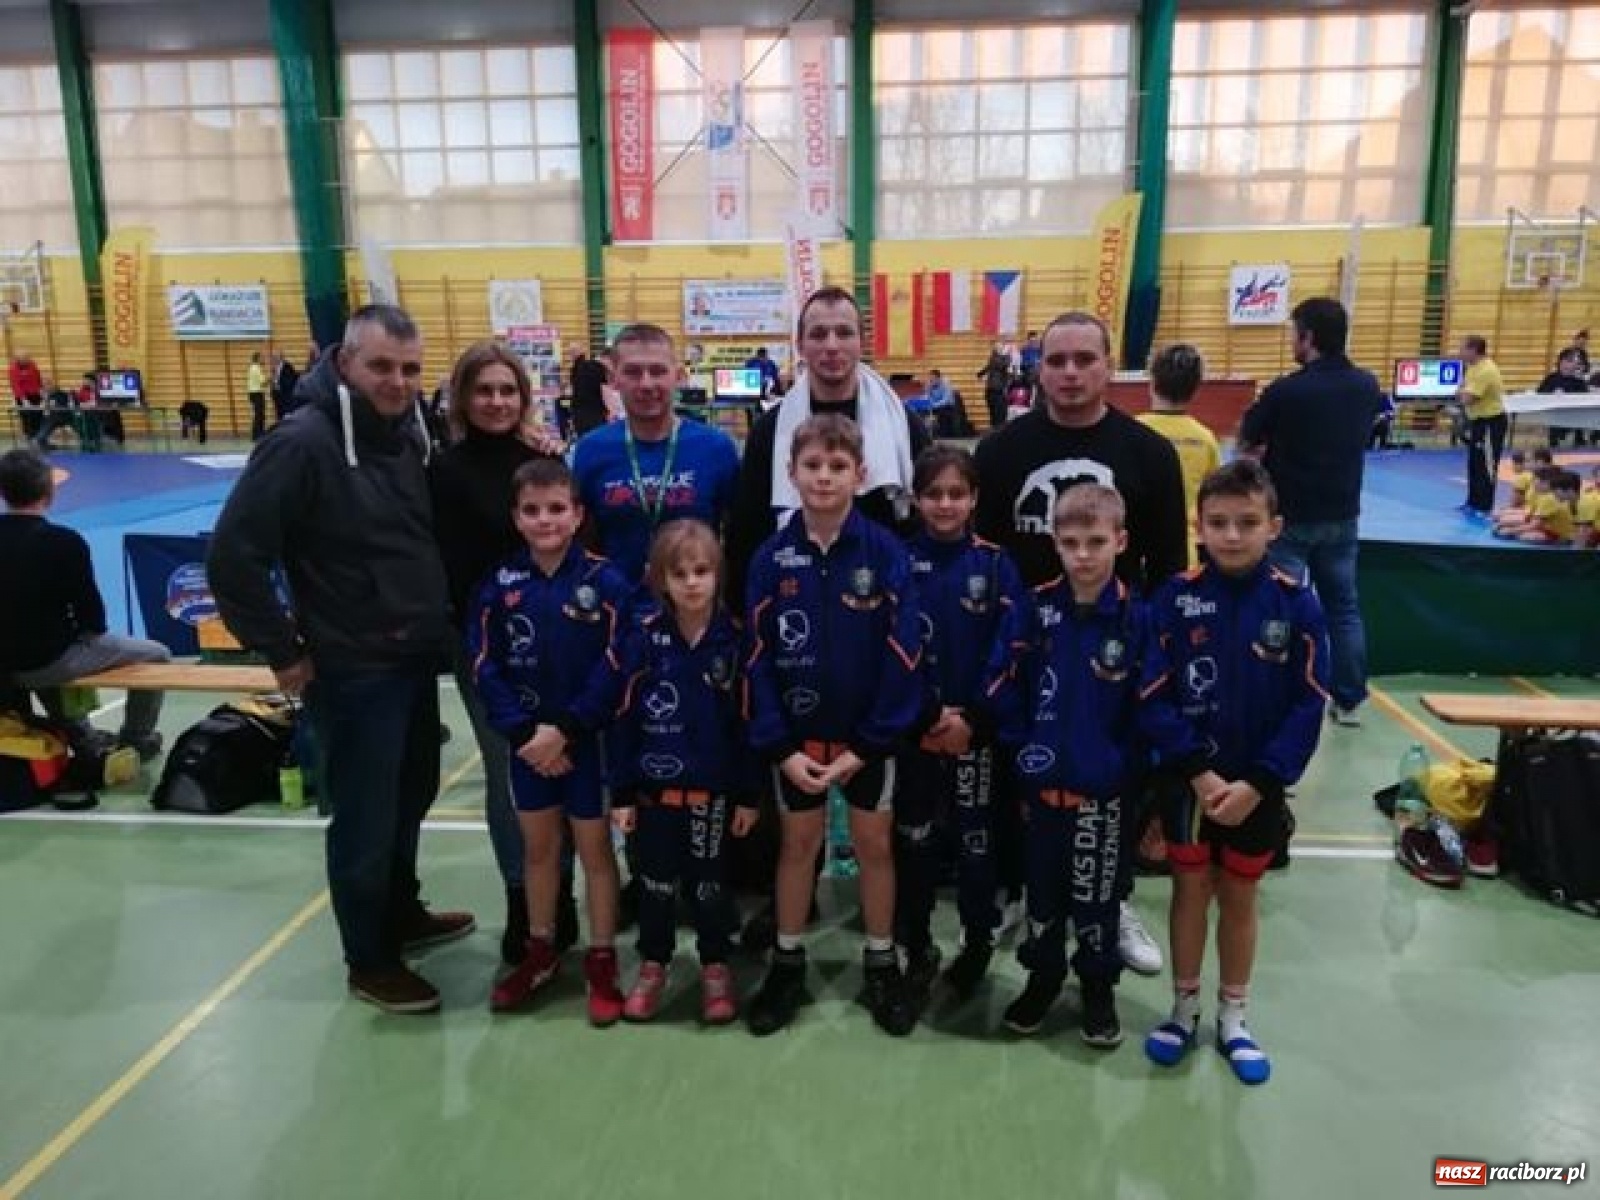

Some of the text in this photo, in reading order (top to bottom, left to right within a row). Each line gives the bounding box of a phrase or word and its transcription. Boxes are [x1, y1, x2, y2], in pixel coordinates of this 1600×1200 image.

[619, 69, 639, 173] GOGOLIN
[802, 61, 823, 167] GOGOLIN
[114, 252, 132, 346] GOGOLIN
[1096, 228, 1121, 319] OGOLIN
[1444, 367, 1455, 381] 0
[1072, 855, 1096, 902] LKS
